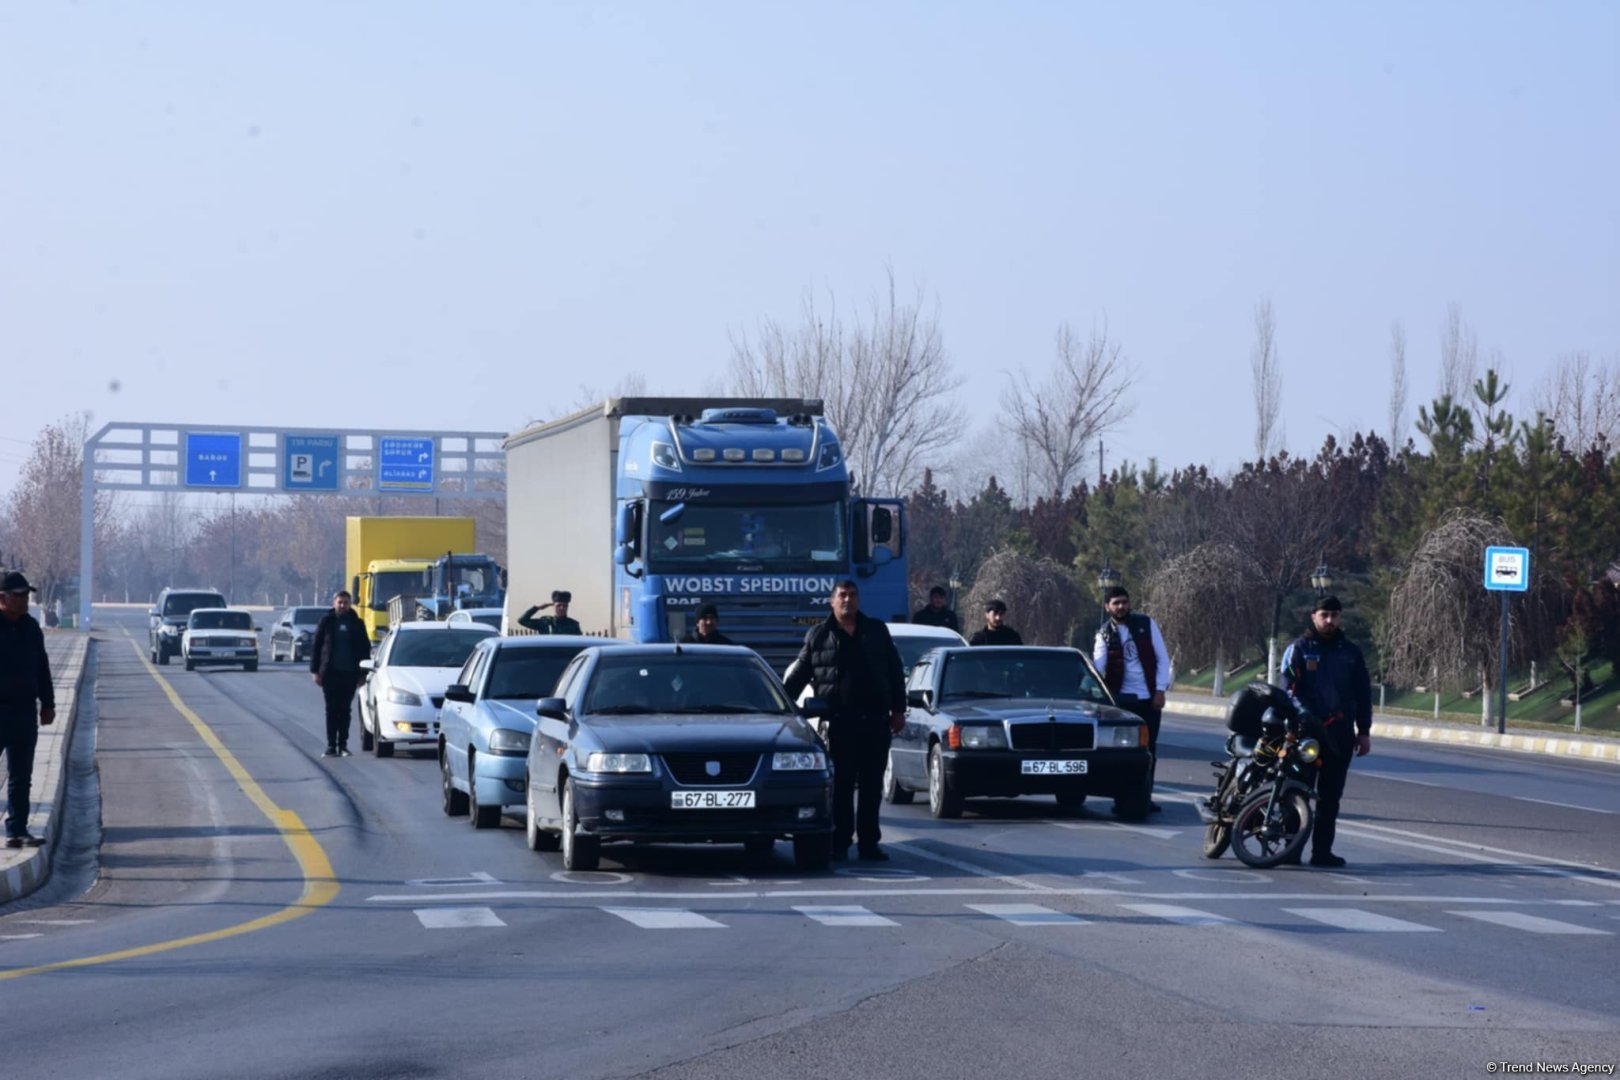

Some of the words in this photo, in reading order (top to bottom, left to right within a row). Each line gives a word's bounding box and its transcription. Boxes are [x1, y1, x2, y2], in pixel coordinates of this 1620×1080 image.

[297, 456, 307, 469] P
[665, 578, 734, 592] WOBST
[740, 577, 834, 592] SPEDITION
[666, 597, 702, 605] DAF
